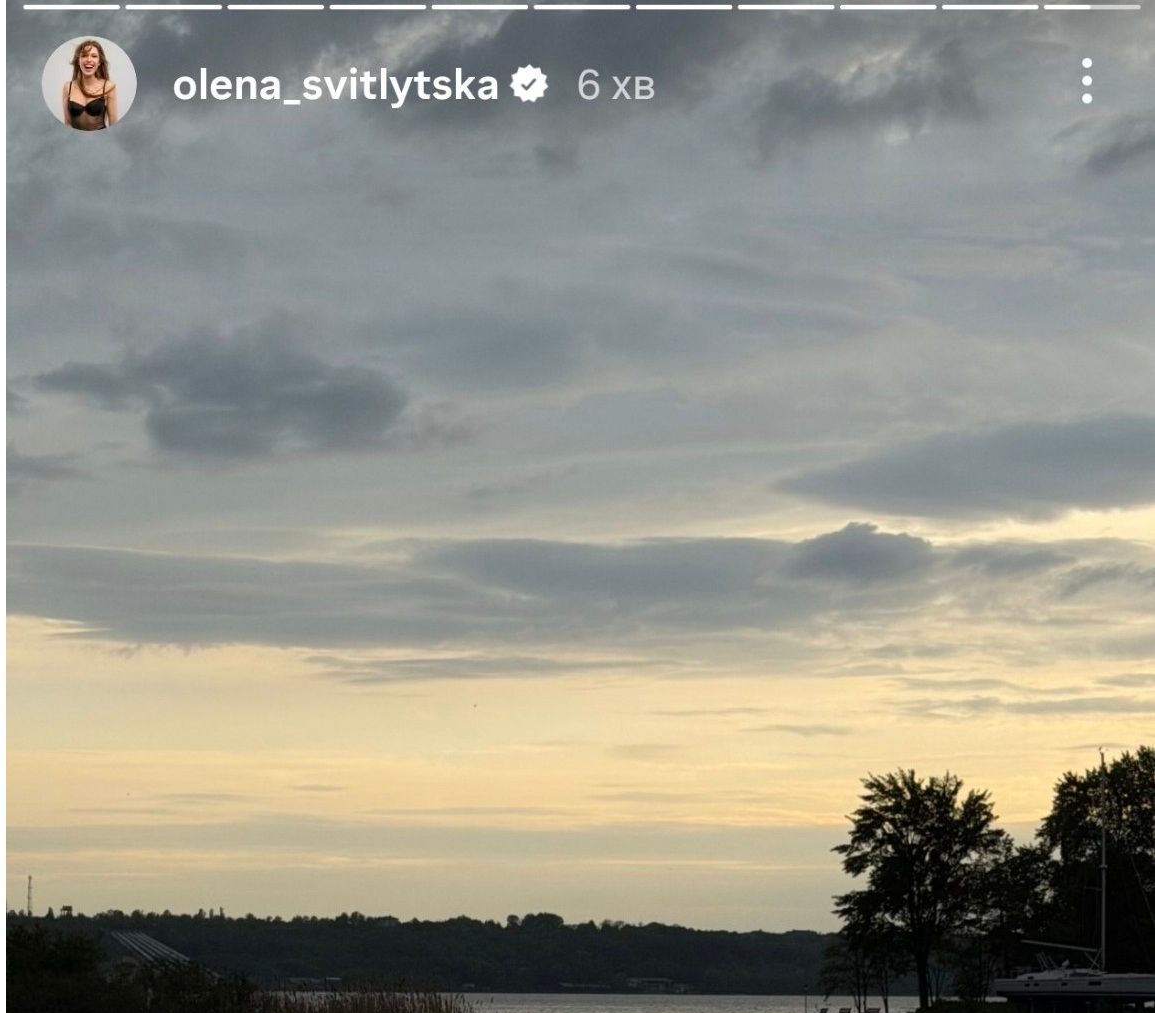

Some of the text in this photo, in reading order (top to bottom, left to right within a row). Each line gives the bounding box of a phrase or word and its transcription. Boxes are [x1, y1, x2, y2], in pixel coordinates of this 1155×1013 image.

[172, 66, 498, 109] olena_svitlytska
[577, 68, 655, 101] 6 хв
